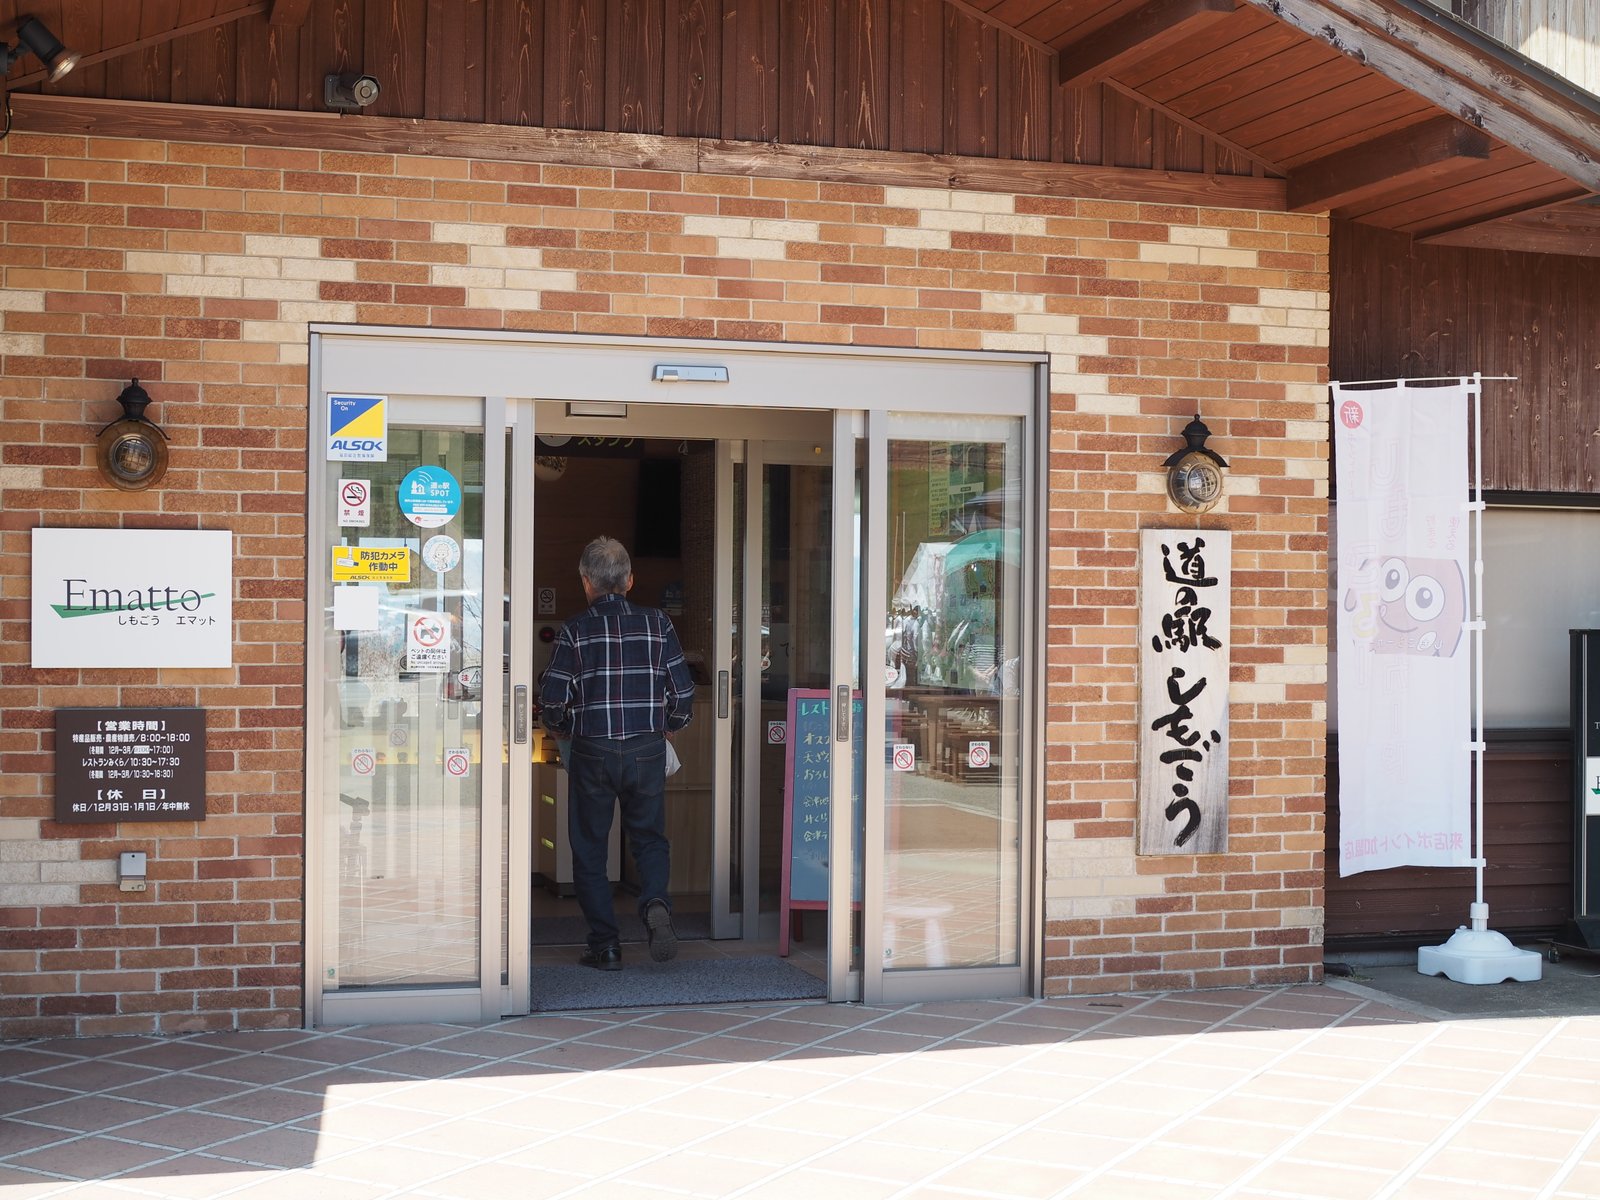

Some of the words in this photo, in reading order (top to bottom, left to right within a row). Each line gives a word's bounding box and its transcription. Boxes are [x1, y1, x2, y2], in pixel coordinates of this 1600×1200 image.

[333, 399, 356, 407] Security
[330, 439, 383, 452] ALSOK
[430, 481, 450, 489] 道の駅
[343, 509, 365, 517] 禁煙
[360, 550, 406, 561] 防犯カメラ
[368, 562, 398, 571] 作動中
[63, 578, 201, 612] Ematto
[1151, 536, 1222, 654] 道の駅
[118, 615, 161, 626] しもごう
[176, 615, 216, 626] エマット
[97, 720, 166, 732] 【営業時間】
[1151, 666, 1221, 848] しもごう
